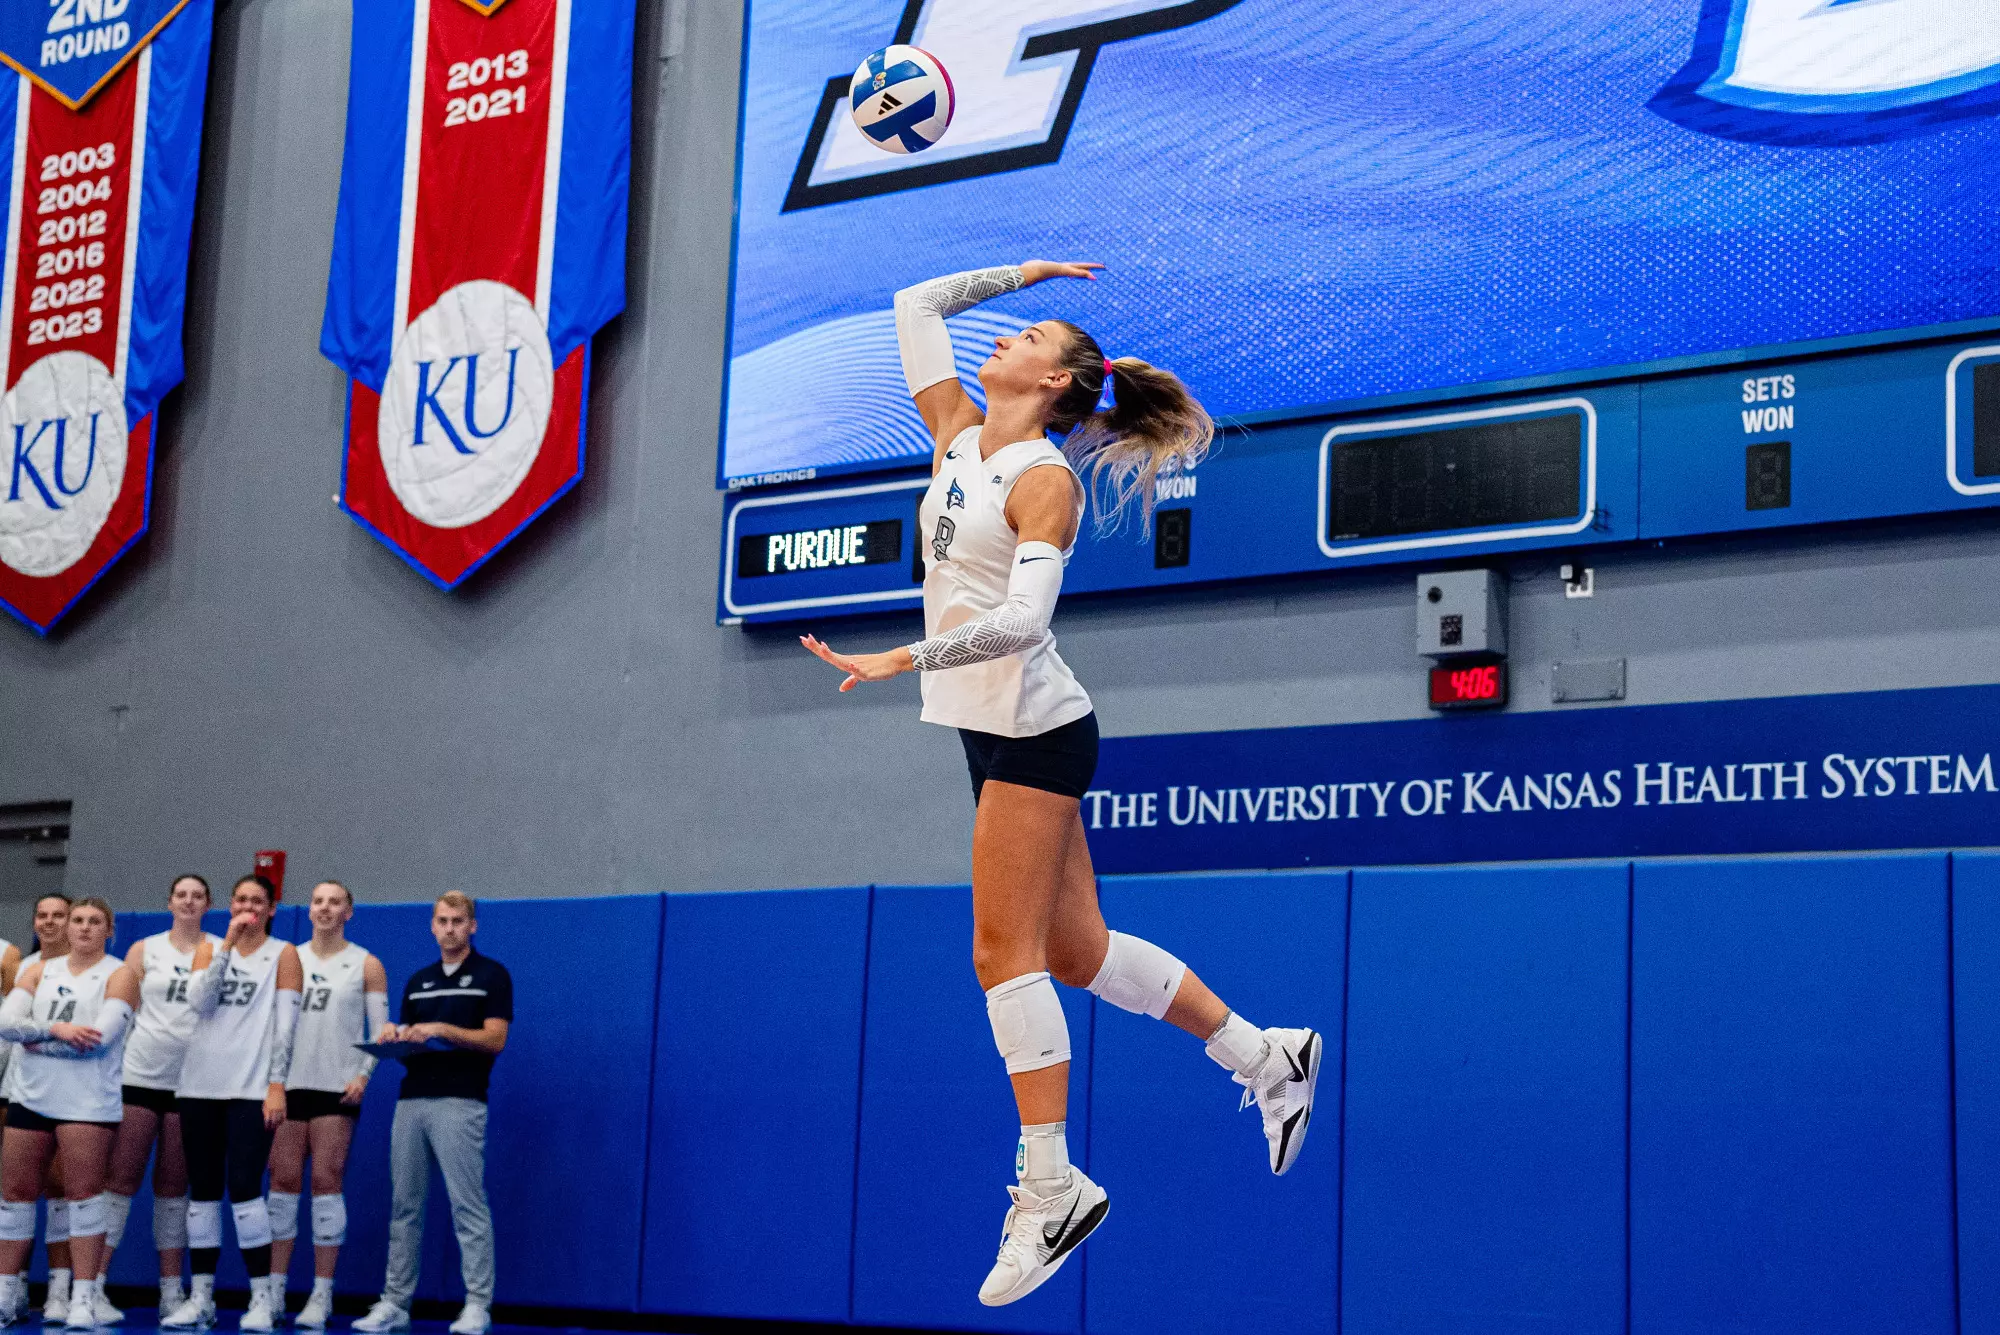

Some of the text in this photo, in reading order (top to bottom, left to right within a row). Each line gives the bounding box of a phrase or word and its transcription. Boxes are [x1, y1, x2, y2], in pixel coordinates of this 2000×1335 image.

[40, 21, 130, 67] ROUND
[446, 49, 529, 92] 2013
[444, 85, 526, 128] 2021
[40, 142, 115, 182] 2003
[37, 175, 112, 215] 2004
[37, 209, 108, 247] 2012
[35, 240, 105, 279] 2016
[29, 274, 106, 313] 2022
[27, 306, 103, 346] 2023
[409, 346, 523, 455] KU
[1742, 374, 1796, 404] SETS
[1741, 404, 1794, 434] WON
[5, 410, 103, 511] KU
[727, 467, 817, 489] DAKTRONICS
[1155, 475, 1197, 500] WON
[766, 525, 868, 574] PURDUE
[1450, 665, 1497, 700] 4:06
[1083, 752, 1999, 829] THE UNIVERSITY OF KANSAS HEALTH SYSTEM
[46, 999, 78, 1024] 14
[218, 979, 258, 1007] 23
[301, 987, 333, 1014] 13
